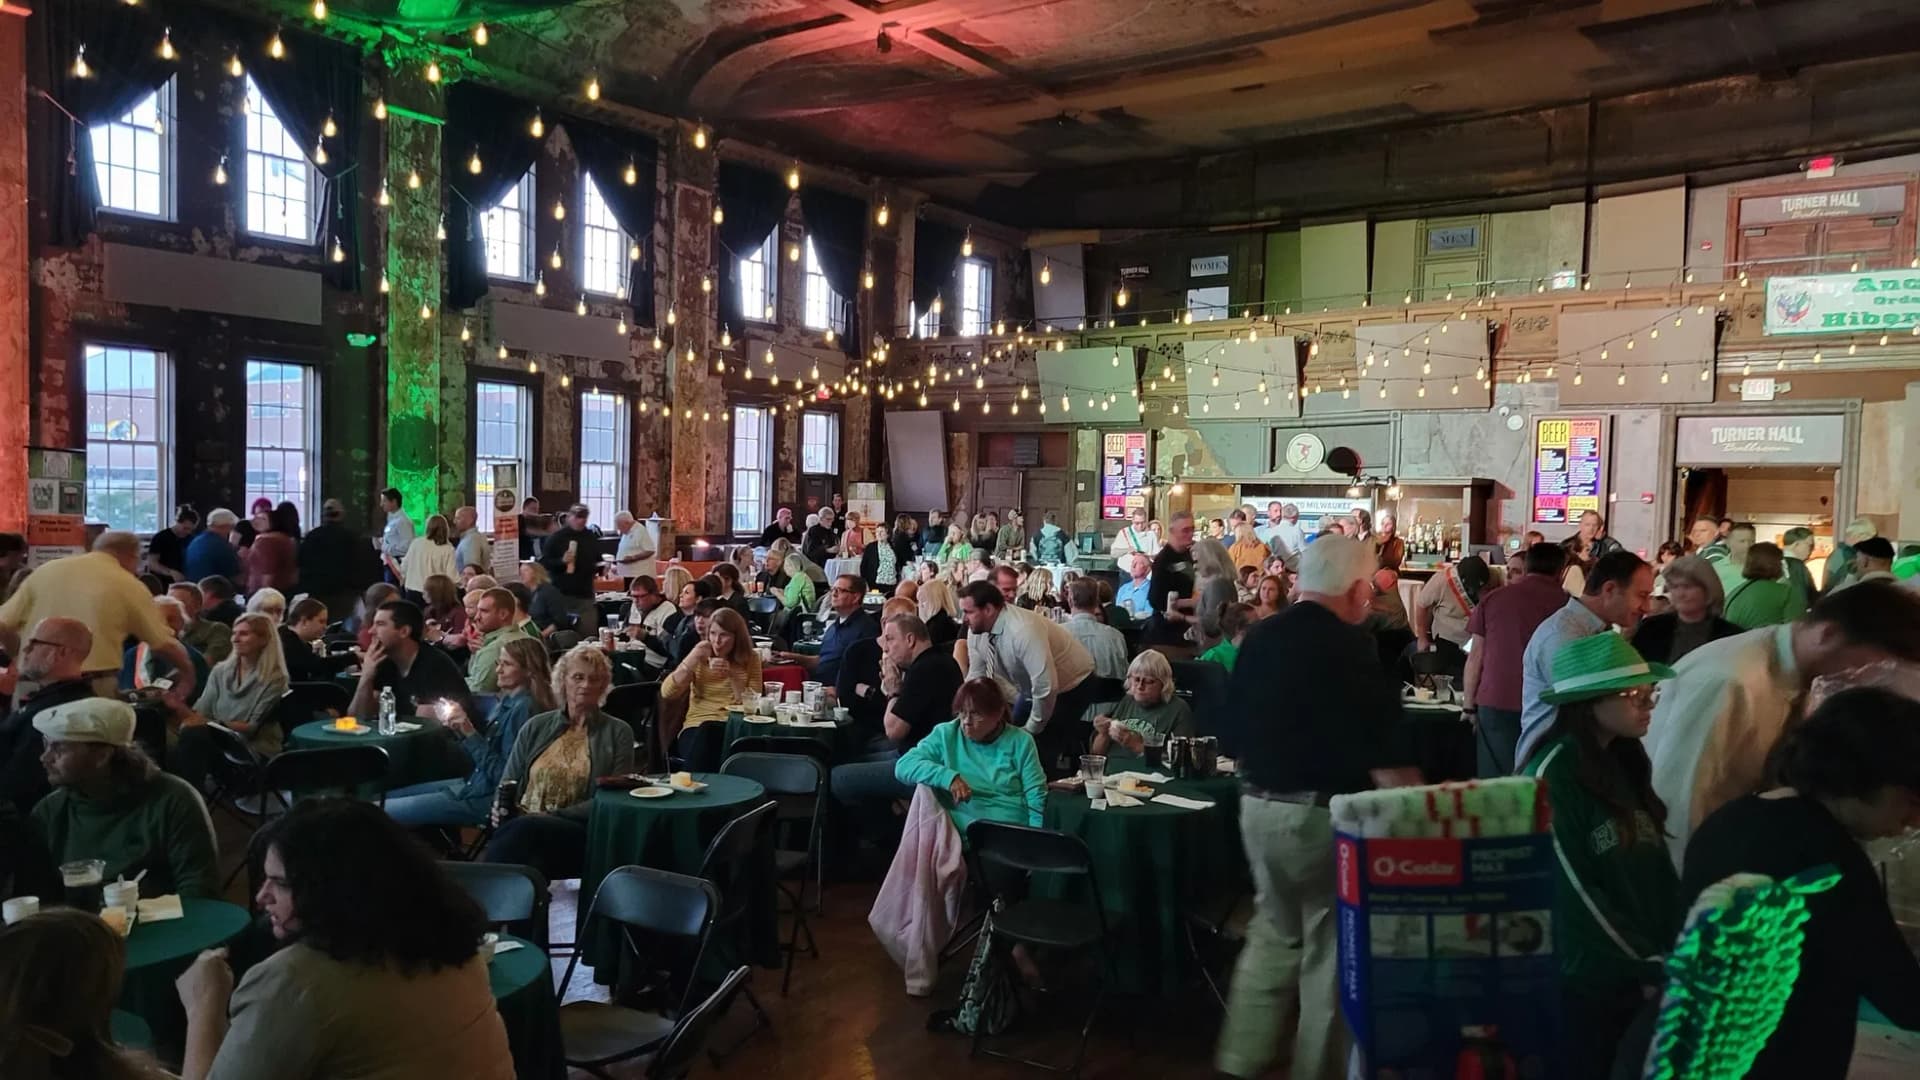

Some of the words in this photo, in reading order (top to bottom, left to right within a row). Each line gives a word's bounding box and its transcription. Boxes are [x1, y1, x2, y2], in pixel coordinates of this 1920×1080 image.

[1782, 195, 1827, 213] TURNER
[1830, 191, 1860, 207] HALL
[1191, 259, 1228, 272] WOMEN
[1542, 422, 1567, 442] BEER
[1711, 426, 1765, 444] TURNER
[1767, 425, 1804, 444] HALL
[1539, 497, 1563, 507] WINE
